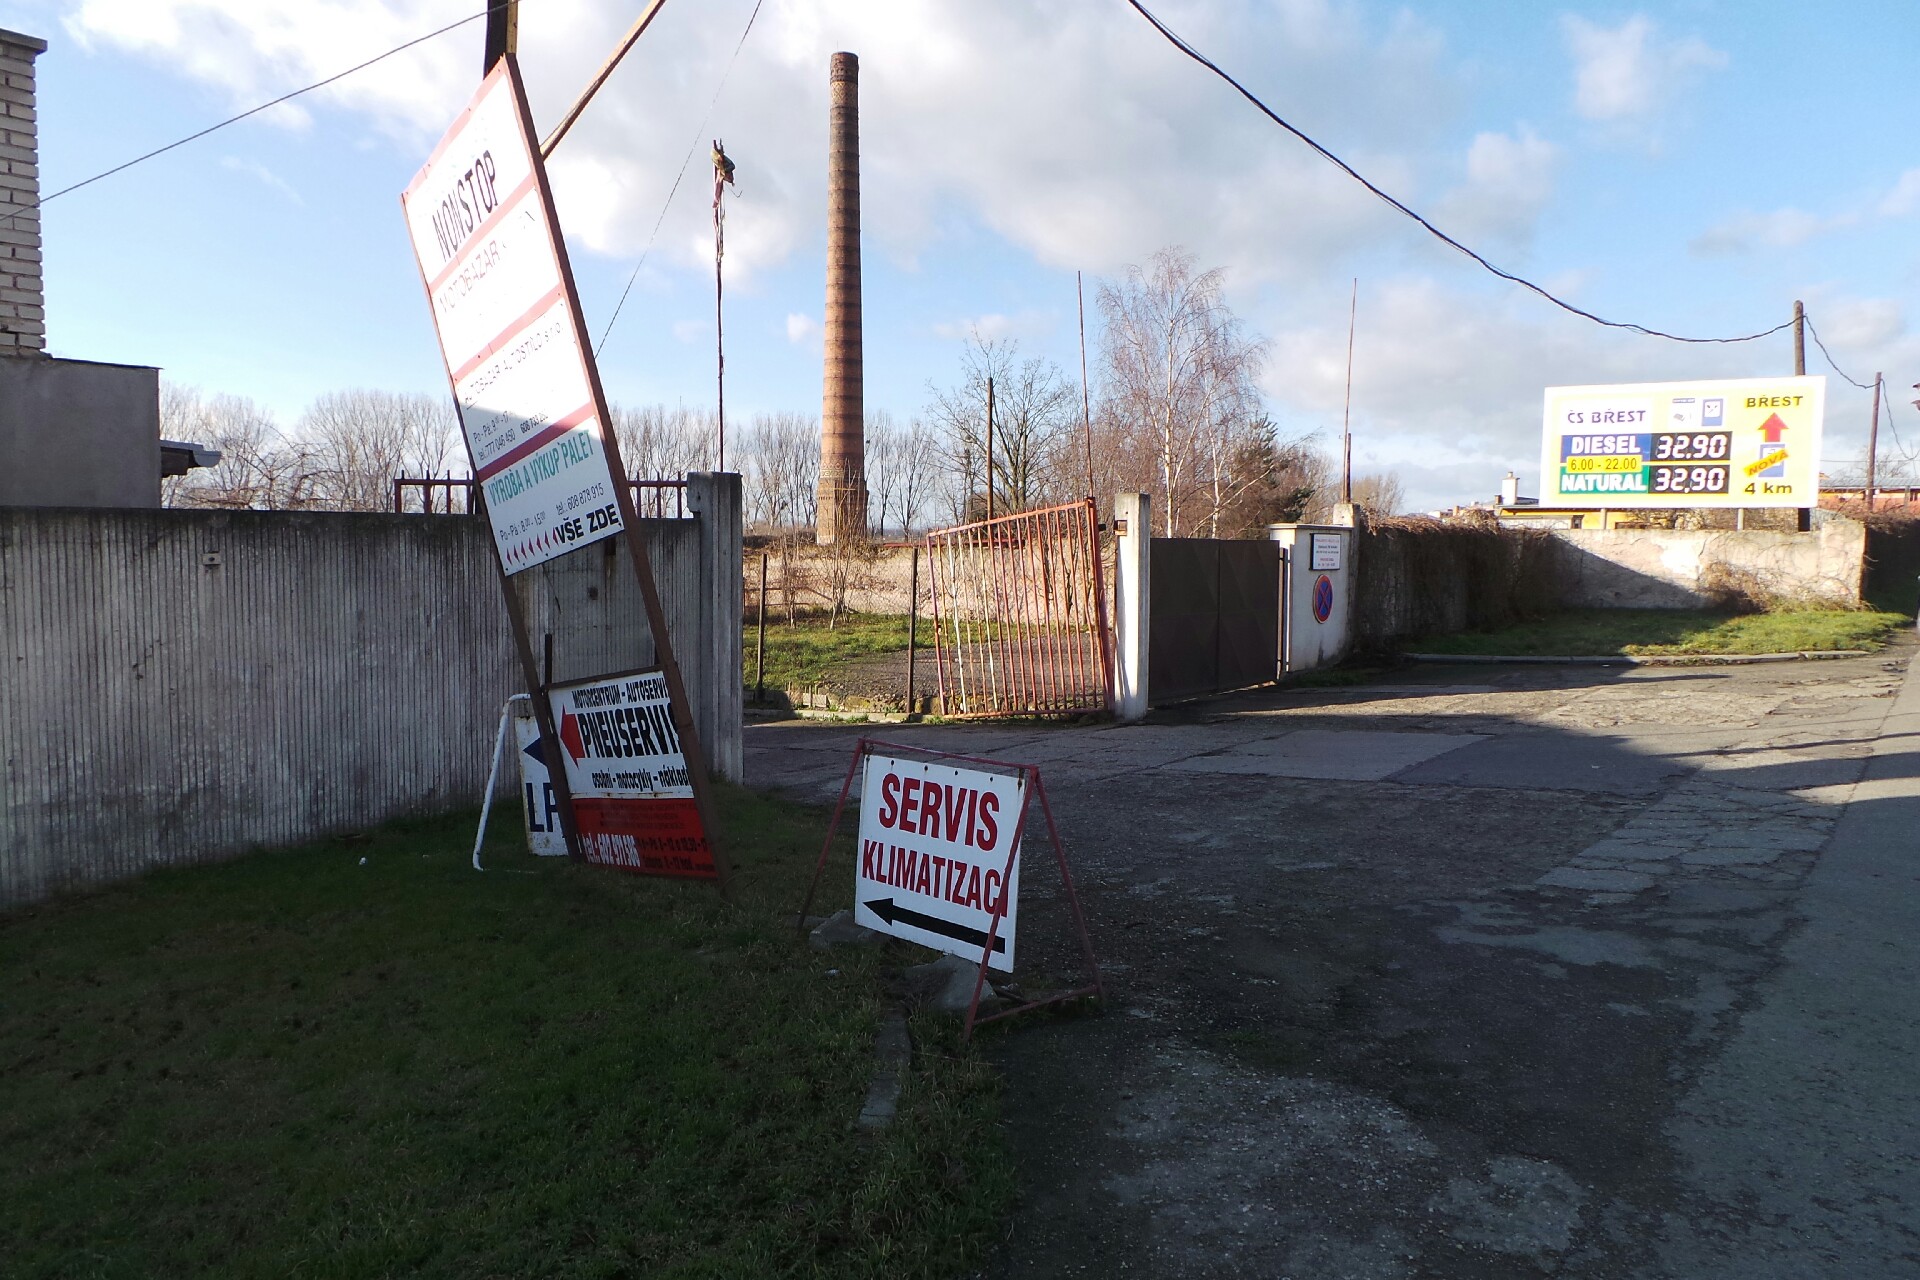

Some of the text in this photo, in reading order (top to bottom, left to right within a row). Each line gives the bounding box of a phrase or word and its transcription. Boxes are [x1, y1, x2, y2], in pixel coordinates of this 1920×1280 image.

[432, 150, 498, 262] NONSTOP
[1746, 395, 1804, 408] BŘEST
[1567, 408, 1647, 424] ČS BŘEST
[1571, 436, 1641, 454] DIESEL
[488, 430, 595, 507] VÝROBA A VÝKUP PALET
[1570, 458, 1594, 471] 6.00
[1605, 457, 1638, 470] 22.00
[590, 482, 605, 499] 915
[1561, 474, 1647, 492] NATURAL
[1744, 482, 1793, 495] 4 km
[555, 503, 620, 544] VŠE ZDE
[571, 684, 622, 709] MOTORCENTRUM
[625, 677, 669, 704] AUTOSERVI
[591, 767, 614, 789] osobní
[615, 768, 654, 792] motocykly
[878, 772, 1000, 852] SERVIS
